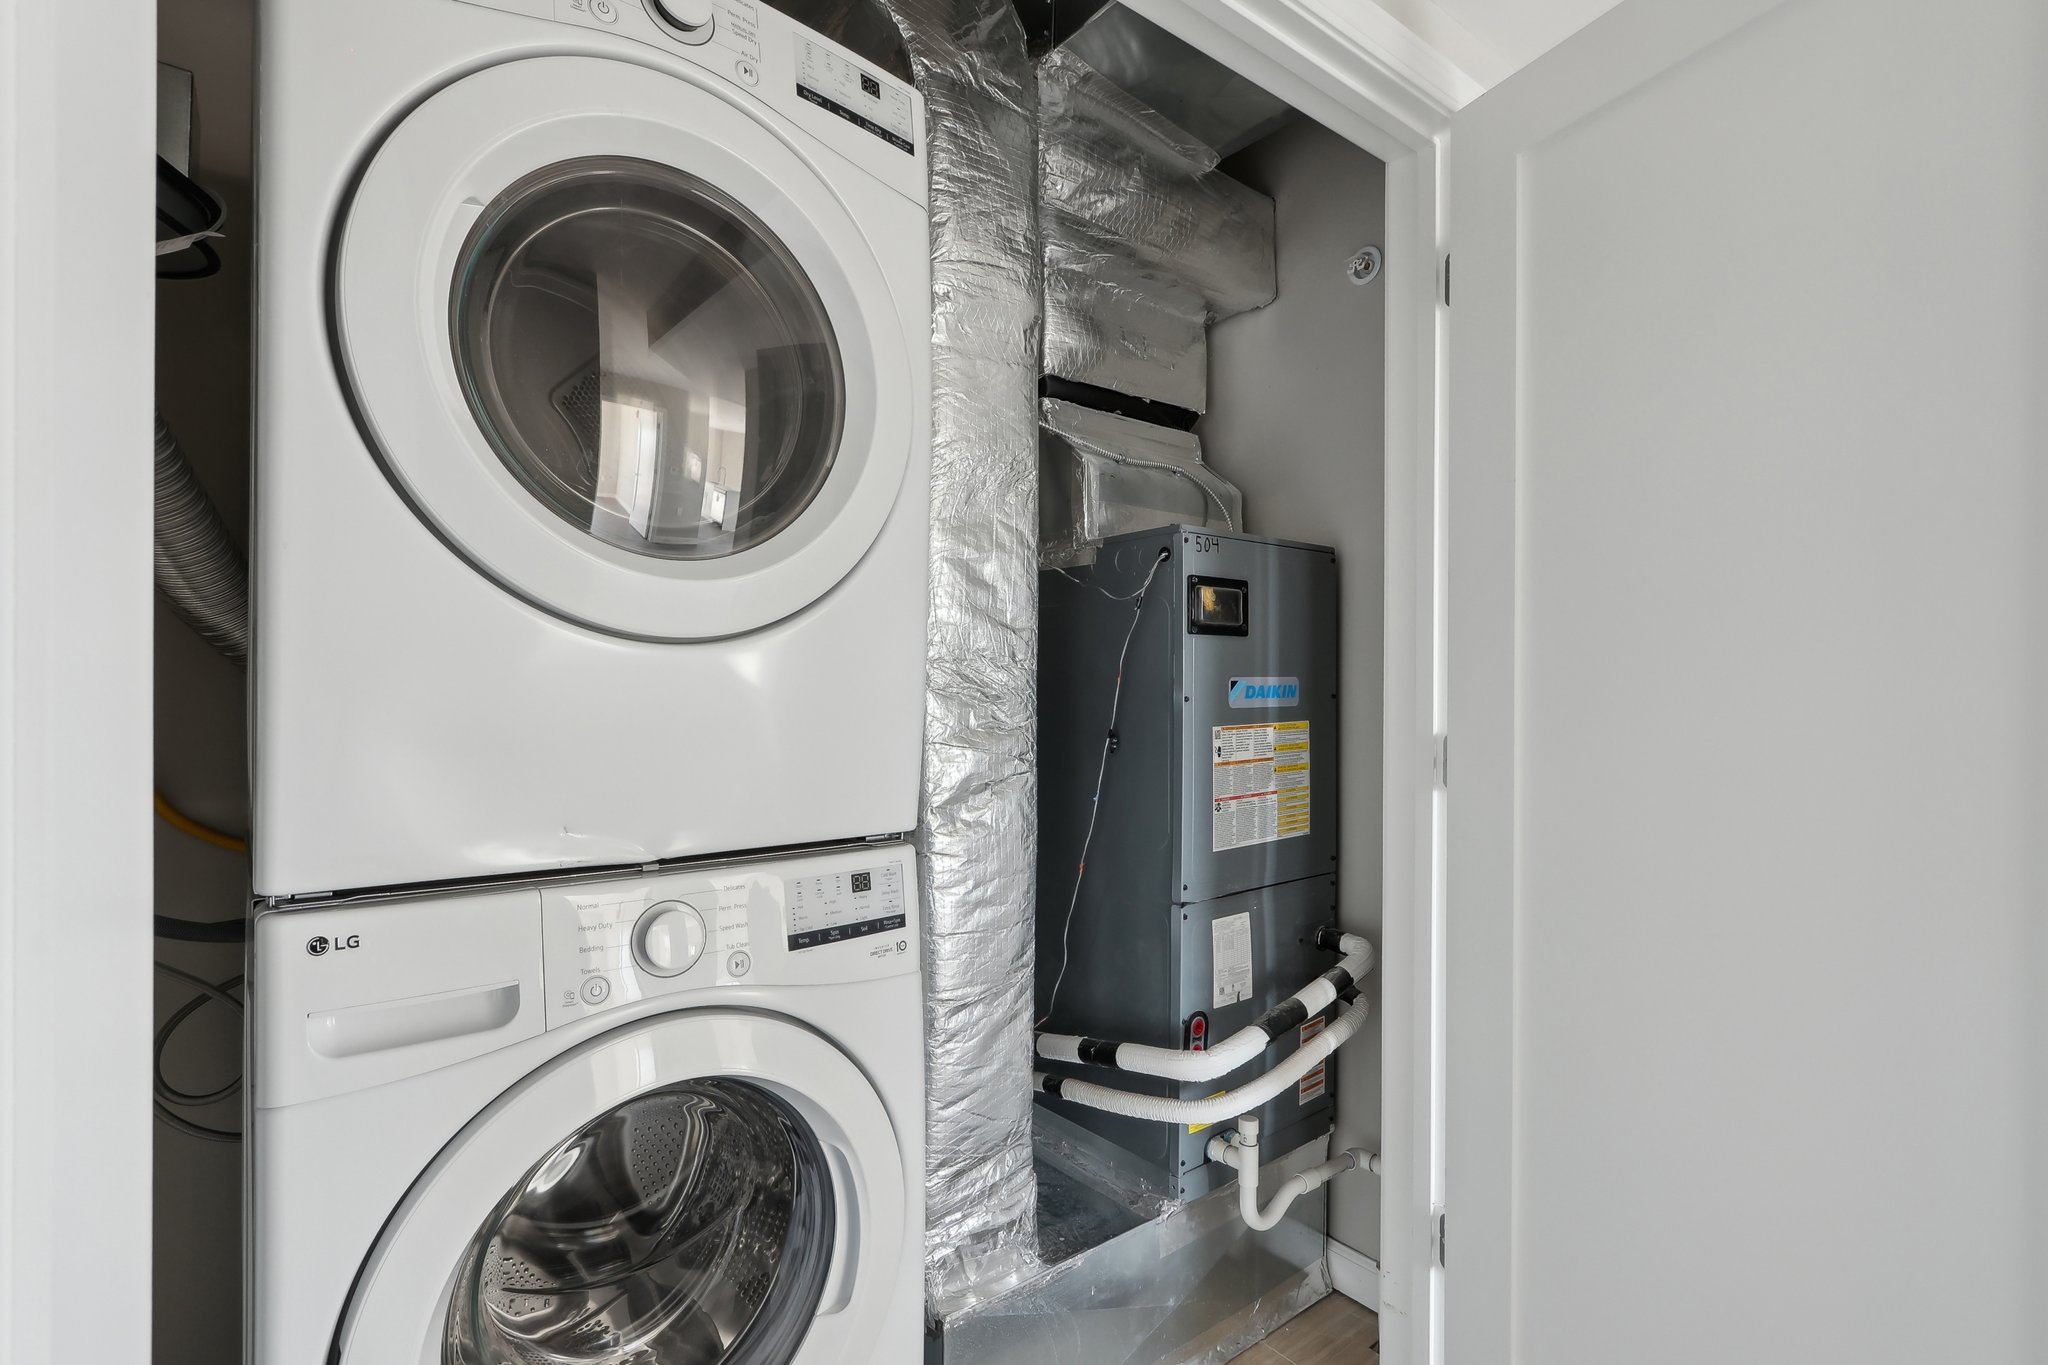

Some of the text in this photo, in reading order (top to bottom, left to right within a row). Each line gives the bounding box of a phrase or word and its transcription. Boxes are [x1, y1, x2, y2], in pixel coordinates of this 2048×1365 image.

[1195, 535, 1219, 554] 504
[1244, 684, 1297, 699] DAIKIN
[723, 884, 746, 892] Delicates
[576, 902, 599, 911] Normal
[578, 922, 613, 933] Heavy Duty
[719, 924, 735, 932] Speed
[334, 935, 361, 951] LG
[579, 944, 604, 954] Bedding
[580, 966, 601, 975] Towels
